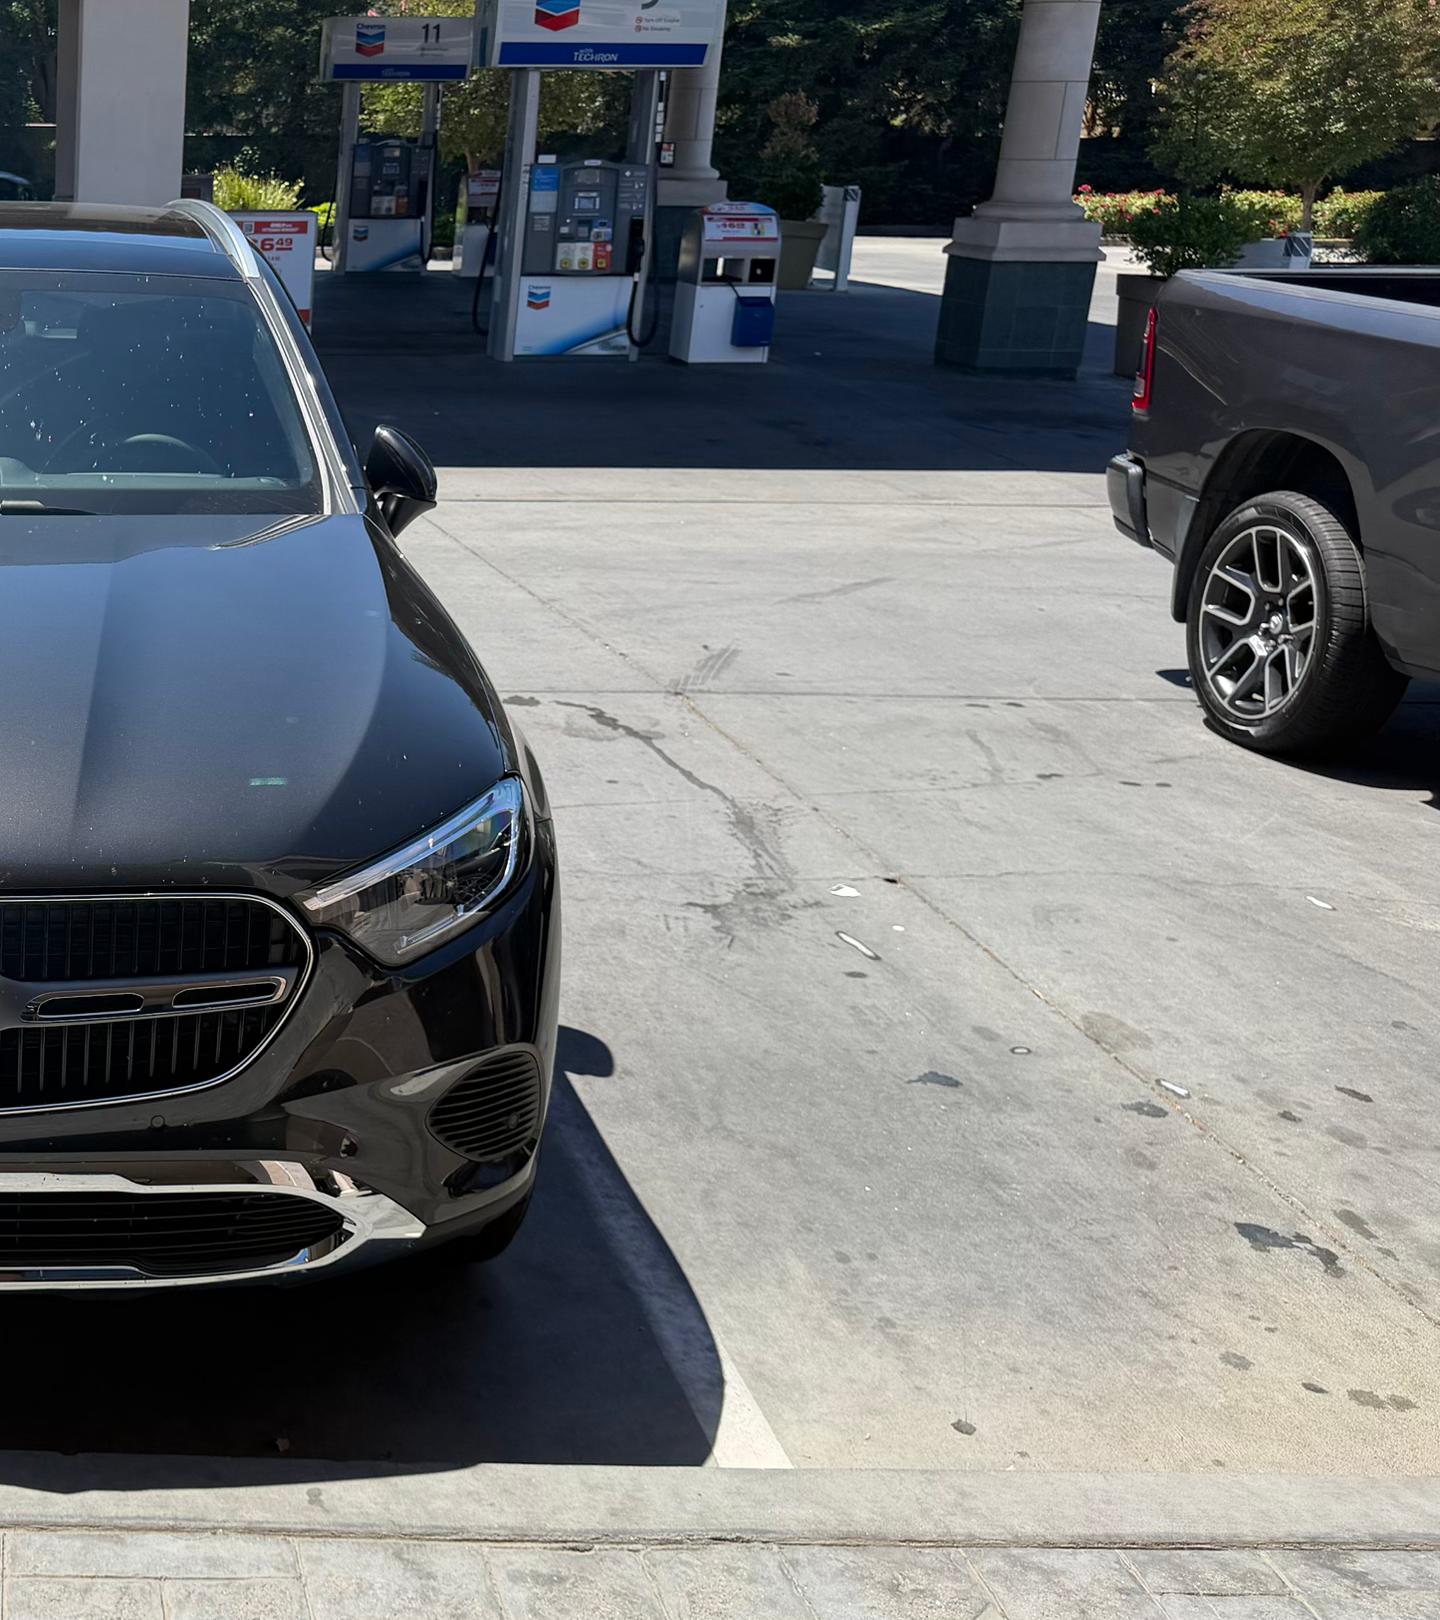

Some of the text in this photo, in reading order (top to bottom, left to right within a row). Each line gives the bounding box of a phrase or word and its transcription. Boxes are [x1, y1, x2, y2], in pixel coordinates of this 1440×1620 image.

[356, 22, 386, 30] Chevron
[421, 23, 441, 43] 11
[573, 52, 619, 62] TECHRON
